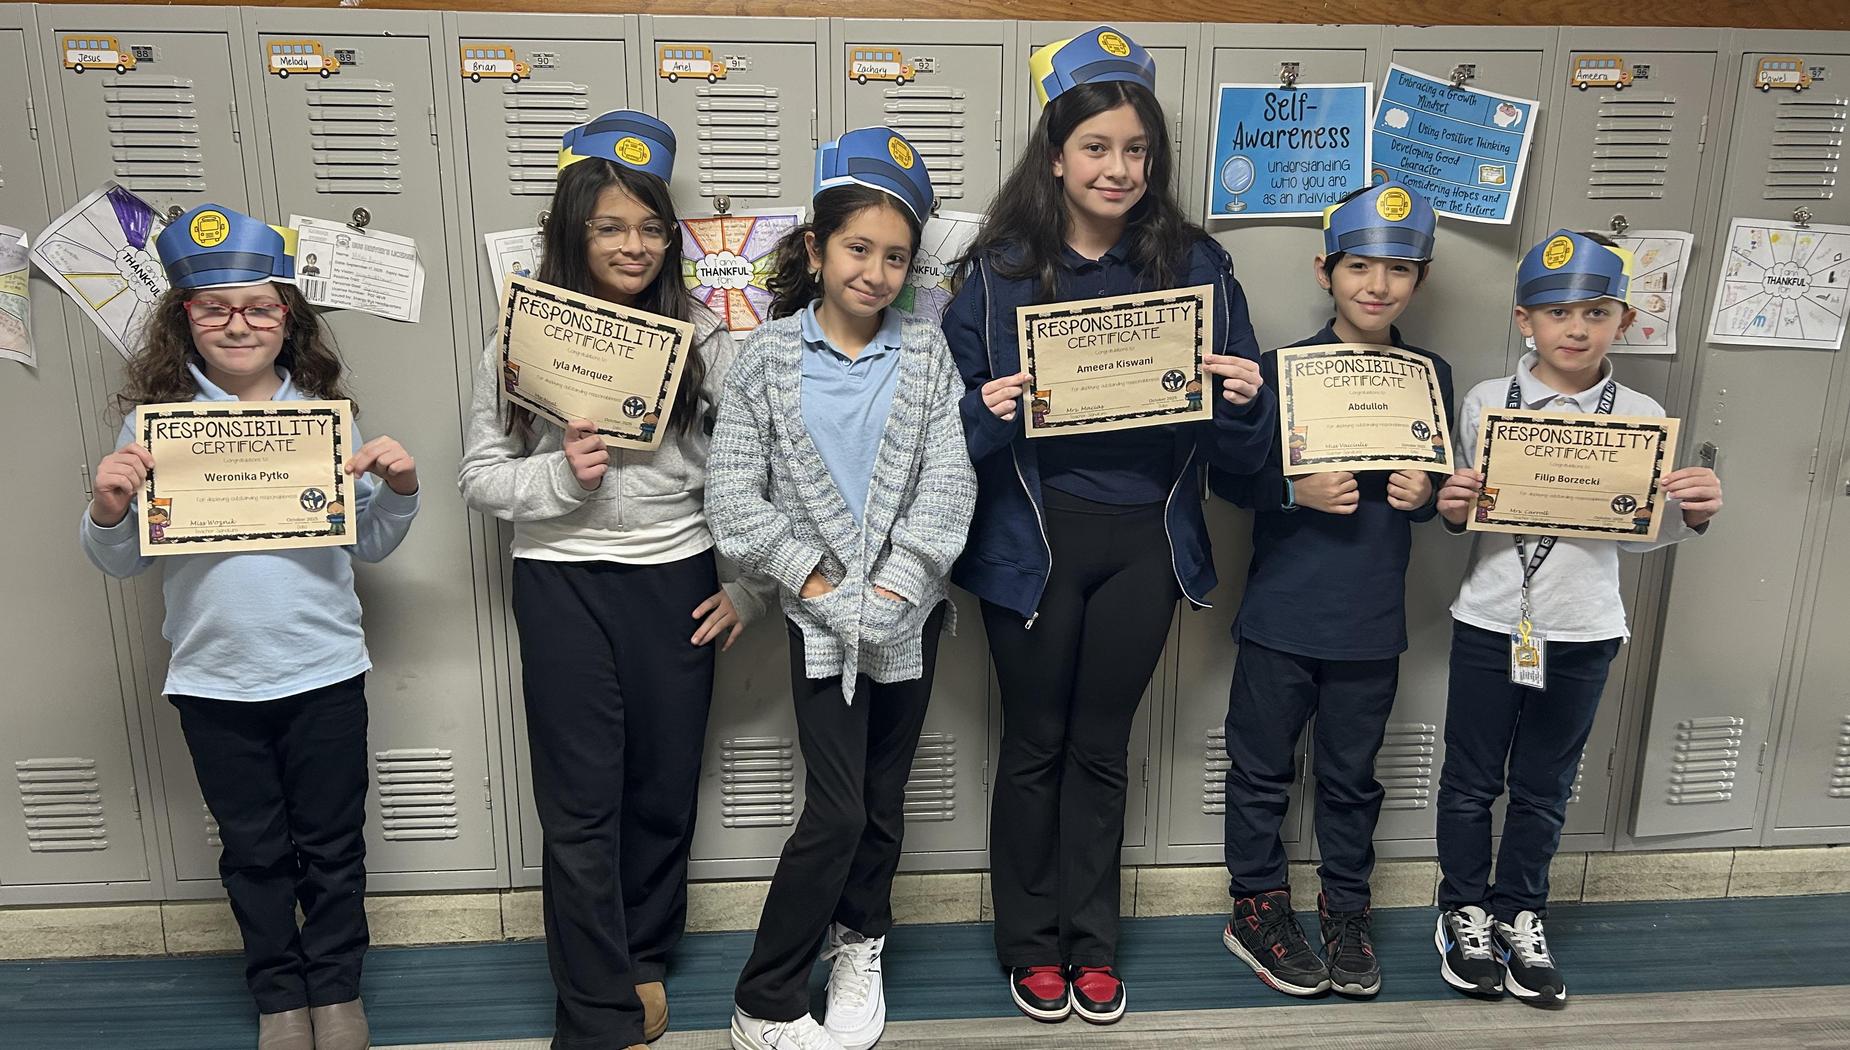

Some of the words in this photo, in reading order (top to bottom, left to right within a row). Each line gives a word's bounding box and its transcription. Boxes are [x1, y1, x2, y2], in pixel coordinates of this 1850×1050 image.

[78, 53, 101, 62] Jesus
[136, 50, 149, 58] 88
[537, 57, 549, 65] 90
[280, 56, 309, 70] Melody
[472, 61, 497, 72] Brian
[672, 61, 692, 72] Ariel
[857, 63, 887, 78] Zachary
[918, 62, 930, 70] 92
[1577, 70, 1608, 80] Ameera
[1761, 71, 1787, 82] Pawel
[1398, 73, 1437, 96] Embracing
[1438, 89, 1445, 97] a
[1446, 89, 1478, 106] Growth
[1263, 91, 1317, 122] Self-
[1416, 94, 1450, 115] Mindset
[1232, 121, 1351, 150] Awareness
[1418, 121, 1439, 140] Using
[1441, 128, 1474, 146] Positive
[1476, 137, 1511, 156] Thinking
[1391, 138, 1434, 162] Developing
[1435, 152, 1460, 166] Good
[1400, 157, 1442, 176] Character
[1302, 176, 1325, 191] you
[1328, 175, 1347, 187] are
[1402, 174, 1450, 197] Considering
[1452, 186, 1479, 201] Hopes
[1481, 193, 1501, 203] and
[1262, 193, 1277, 205] as
[1279, 193, 1294, 204] an
[1297, 191, 1351, 204] individua
[1433, 195, 1447, 208] for
[1449, 199, 1463, 211] the
[122, 252, 161, 298] THANKFUL
[700, 266, 749, 277] THANKFUL
[1767, 276, 1806, 287] THANKFUL
[518, 296, 671, 352] RESPONSIBILITY
[1037, 304, 1192, 339] RESPONSIBILITY
[543, 324, 636, 360] CERTIFICATE
[1067, 326, 1161, 350] CERTIFICATE
[552, 358, 570, 371] Iyla
[571, 365, 613, 383] Marquez
[1076, 362, 1114, 373] Ameera
[1116, 356, 1153, 369] Kiswani
[1295, 358, 1423, 381] RESPONSIBILITY
[1323, 375, 1406, 389] CERTIFICATE
[1348, 402, 1389, 411] Abdulloh
[156, 418, 328, 440] RESPONSIBILITY
[1497, 425, 1654, 450] RESPONSIBILITY
[191, 438, 297, 455] CERTIFICATE
[1524, 444, 1619, 463] CERTIFICATE
[204, 471, 257, 482] Weronika
[259, 471, 289, 483] Pytko
[1534, 472, 1556, 483] Filip
[1557, 474, 1600, 486] Borzecki
